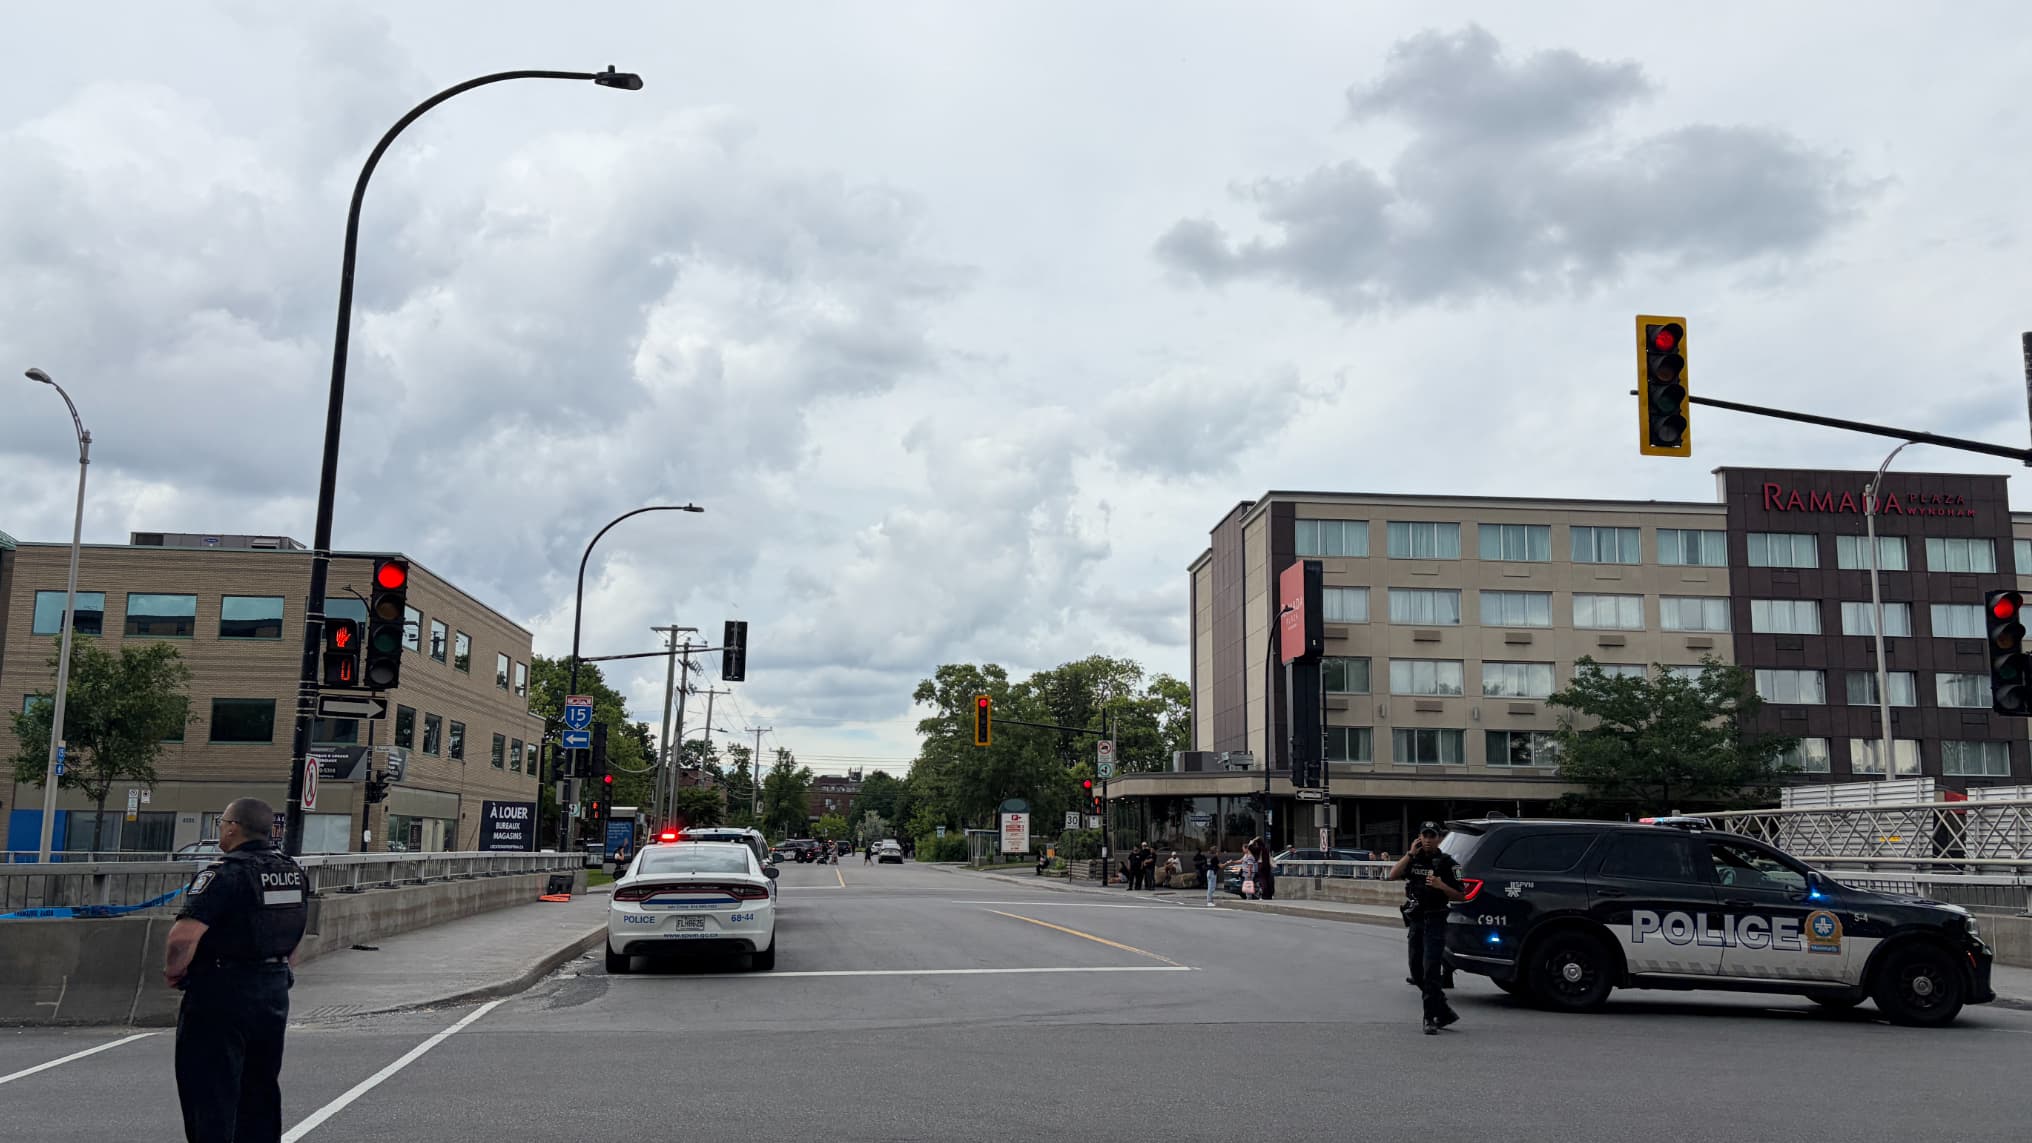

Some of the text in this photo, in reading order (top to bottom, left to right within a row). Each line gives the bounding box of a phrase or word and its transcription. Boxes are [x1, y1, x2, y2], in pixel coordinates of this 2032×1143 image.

[1764, 482, 1903, 513] RAMADA
[1909, 493, 1966, 505] PLAZA
[1907, 507, 1977, 518] WYNDHAM
[570, 708, 586, 721] 15
[490, 802, 528, 819] À LOUER
[495, 821, 521, 830] BUREAUX
[1067, 815, 1078, 825] 30
[493, 832, 523, 840] MAGASINS
[261, 872, 301, 886] POLICE
[624, 915, 655, 924] POLICE
[731, 914, 754, 922] 68-44
[1485, 915, 1507, 926] 911
[1632, 909, 1801, 951] POLICE
